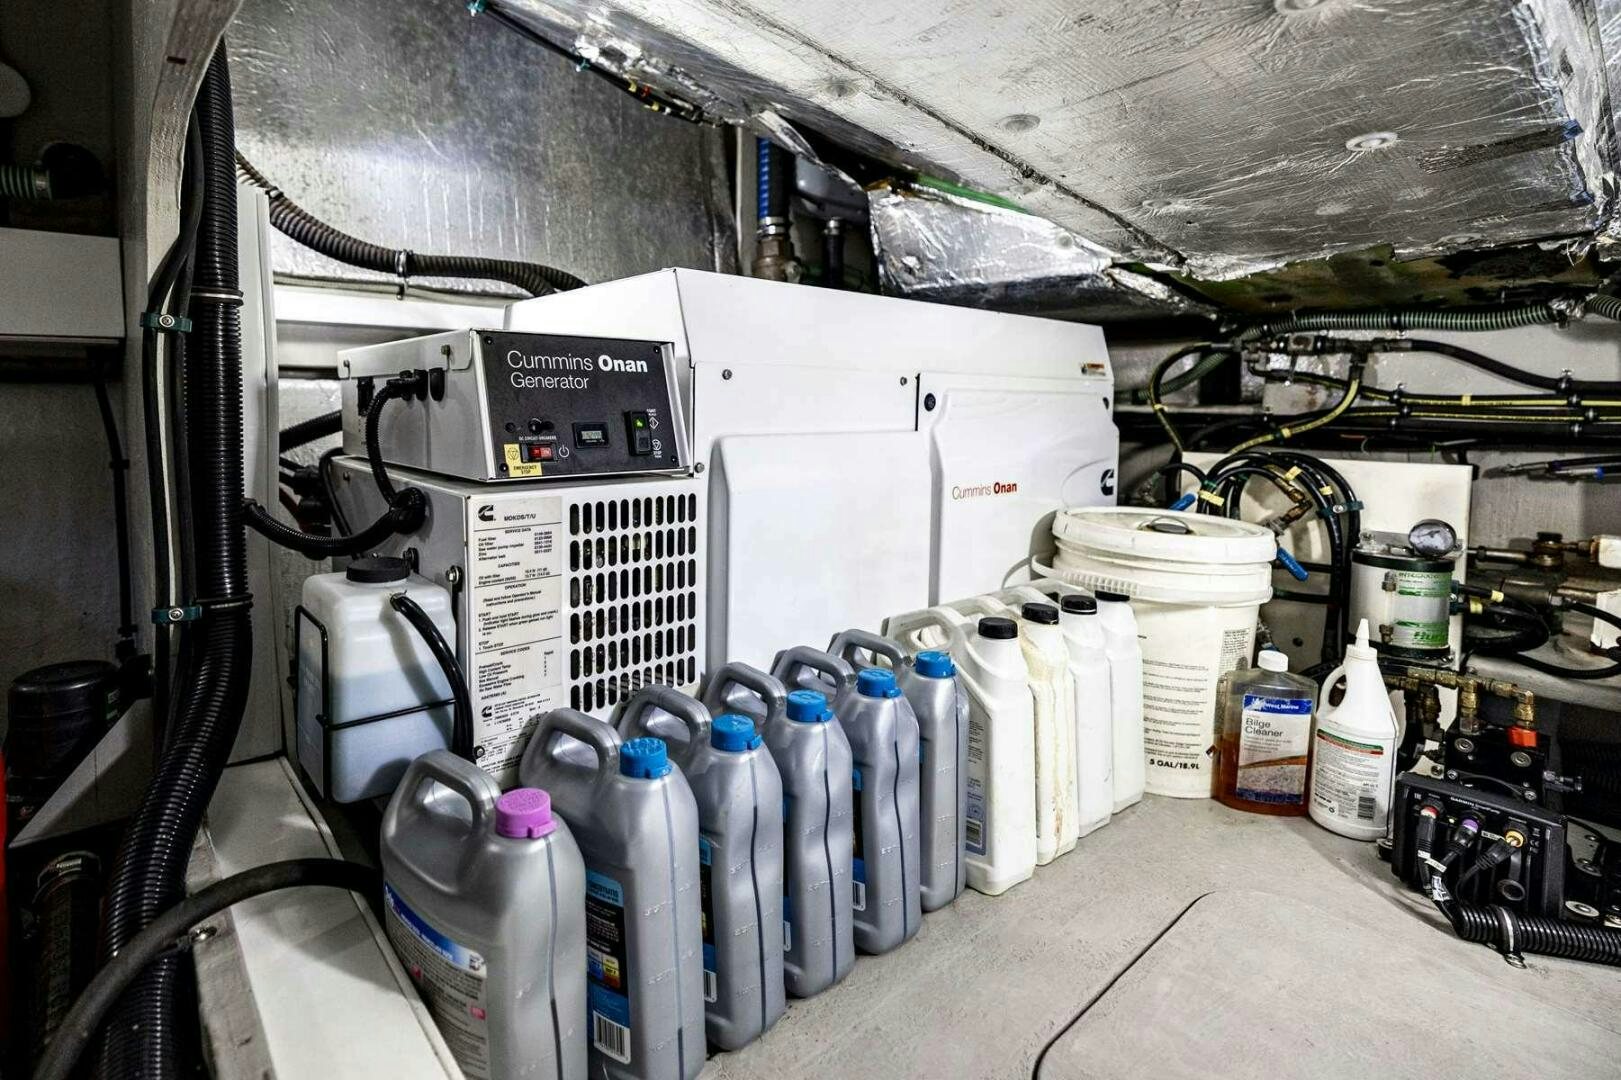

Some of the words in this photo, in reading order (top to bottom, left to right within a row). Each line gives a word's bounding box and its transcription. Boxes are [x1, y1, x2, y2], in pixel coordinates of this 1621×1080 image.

[507, 350, 594, 371] Cummins
[598, 354, 648, 372] Onan
[510, 372, 589, 389] Generator
[952, 484, 991, 500] Cummins
[994, 482, 1017, 494] Onan
[1245, 726, 1284, 737] Cleaner
[1246, 718, 1270, 729] Bilge
